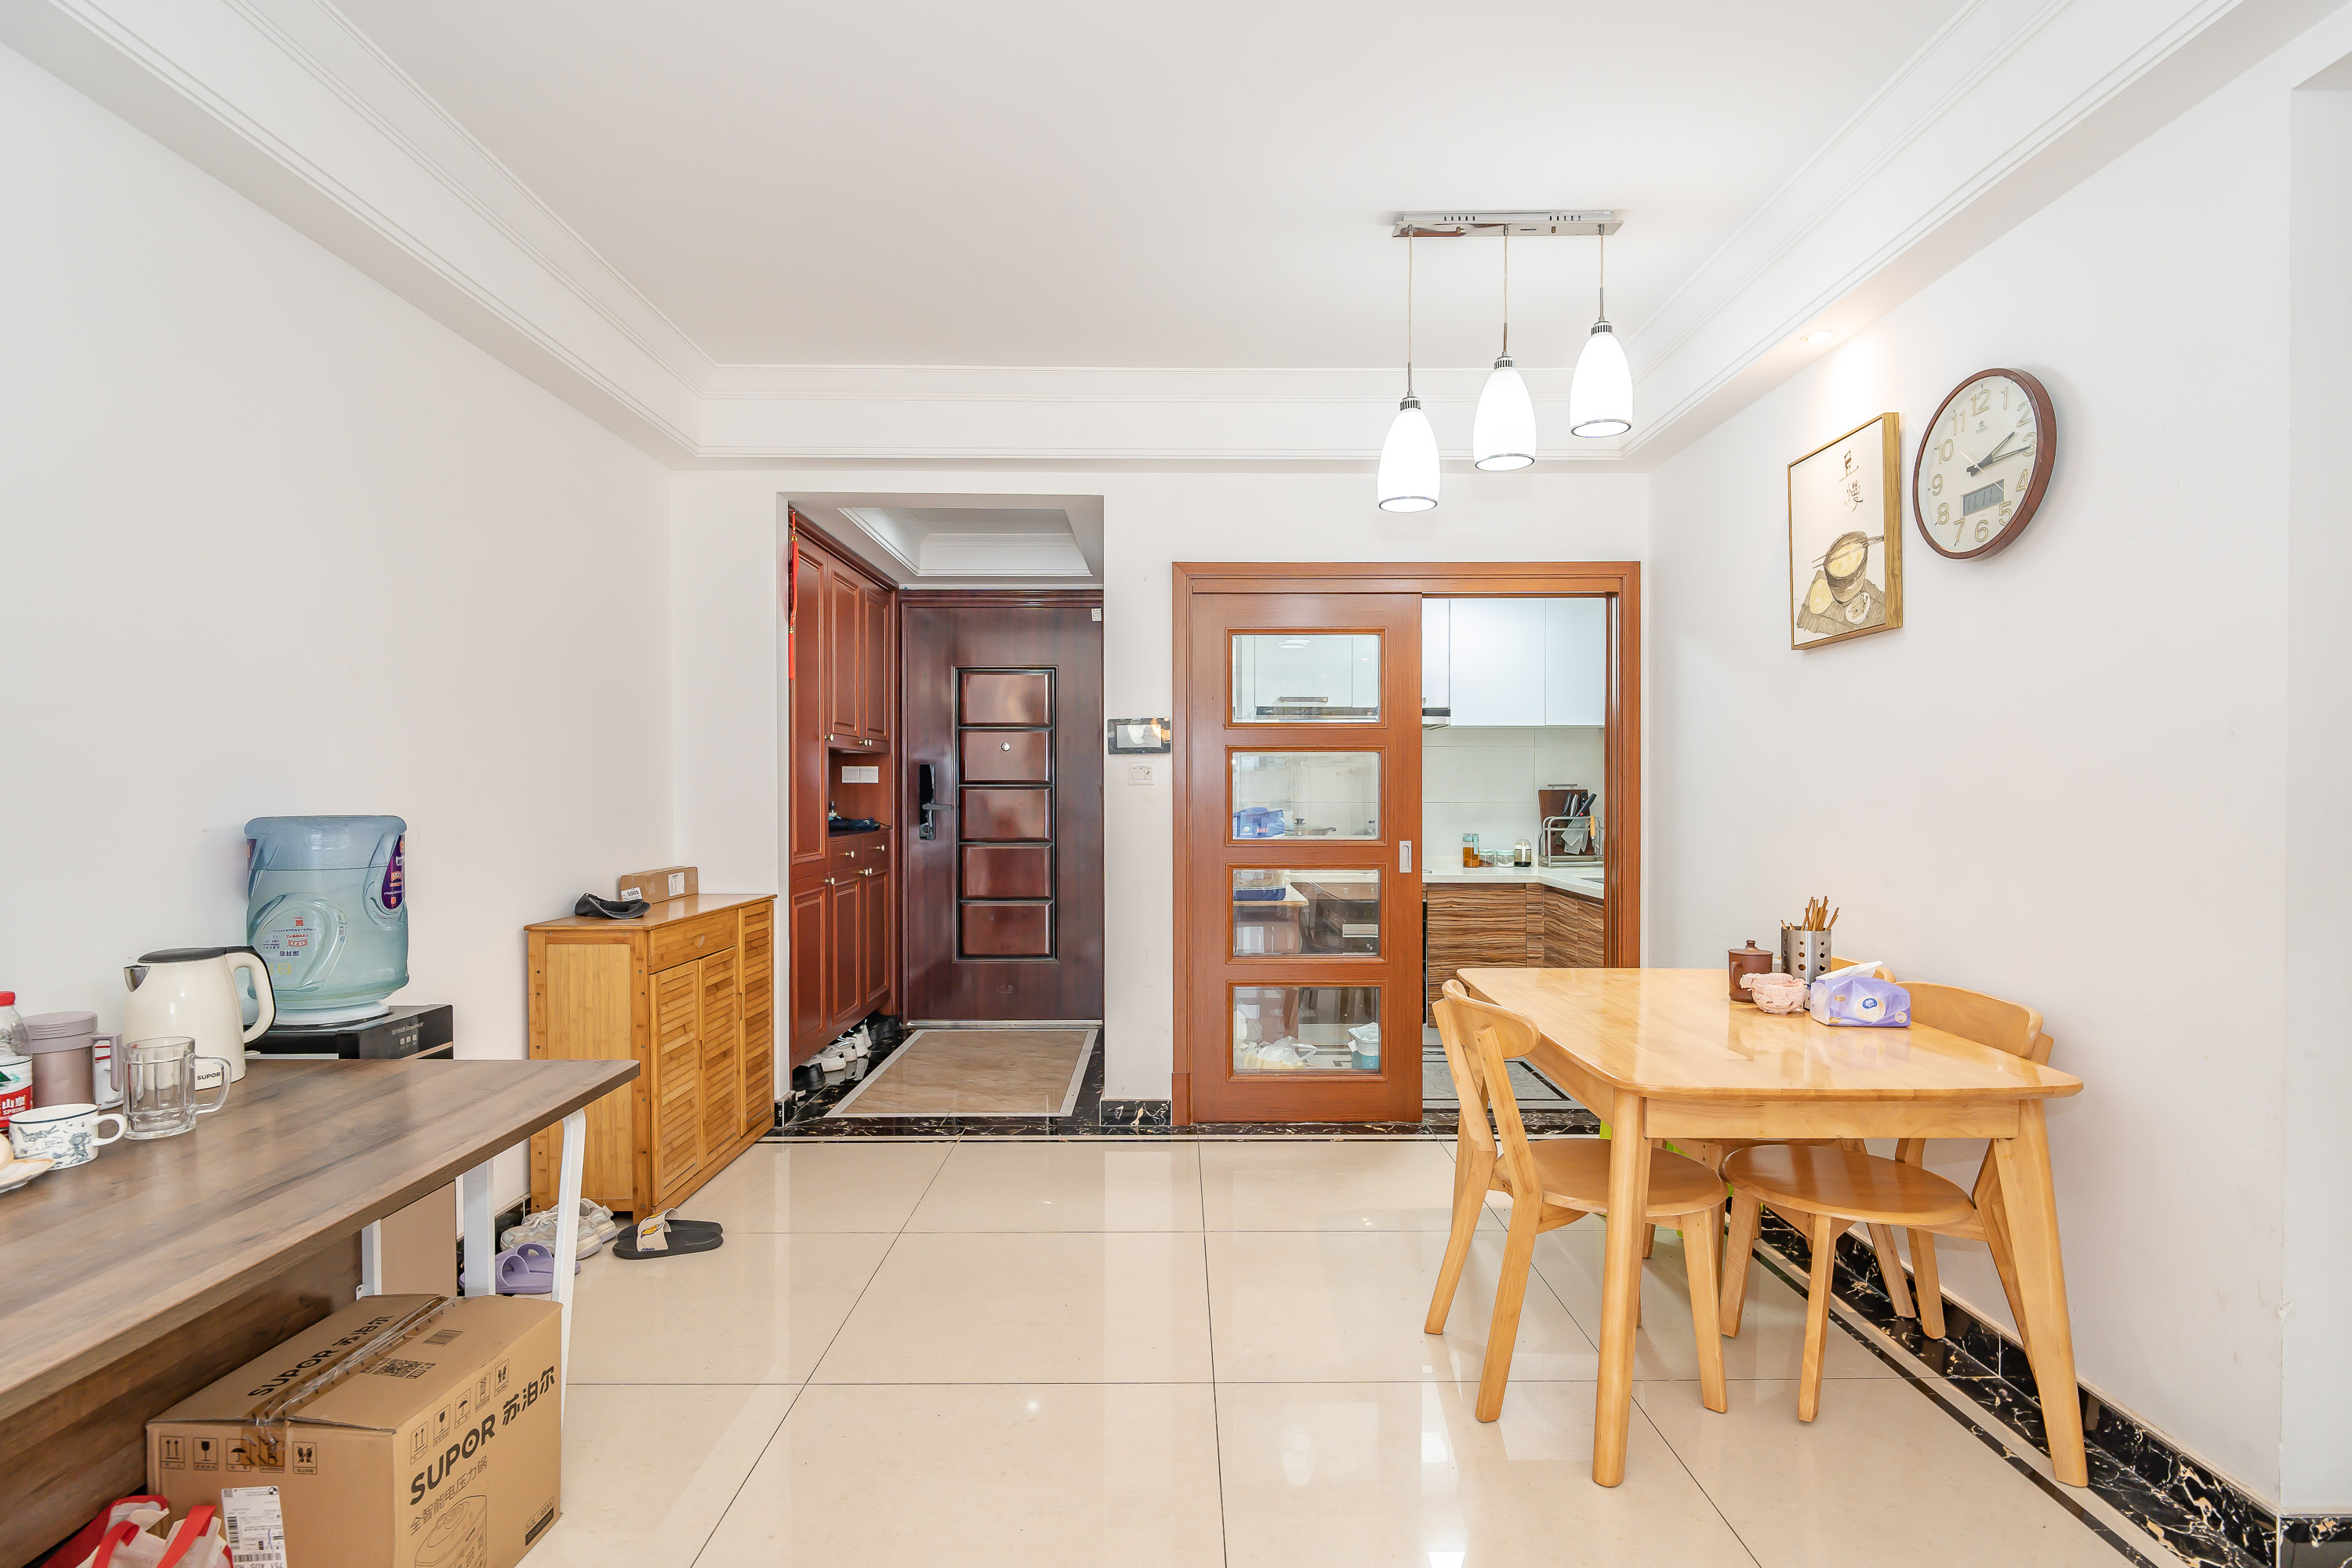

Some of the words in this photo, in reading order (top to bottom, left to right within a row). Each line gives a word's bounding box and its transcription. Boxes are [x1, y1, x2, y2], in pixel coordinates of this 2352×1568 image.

[1970, 389, 1990, 416] 12
[2001, 387, 2008, 410] 1
[1951, 410, 1965, 436] 11
[2016, 401, 2031, 428] 2
[1936, 439, 1954, 464] 10
[2022, 432, 2037, 457] 3
[1932, 474, 1944, 495] 9
[2016, 469, 2028, 492] 4
[1937, 503, 1950, 524] 8
[1999, 501, 2013, 526] 5
[1954, 518, 1965, 543] 7
[1974, 520, 1989, 543] 6
[197, 1072, 221, 1080] SUPOR
[0, 1094, 26, 1111] 山泉
[248, 1349, 339, 1397] SUPOR
[410, 1414, 495, 1505] SUPOR
[502, 1365, 556, 1427] 苏泊尔
[410, 1455, 488, 1536] 全智能电压力锅
